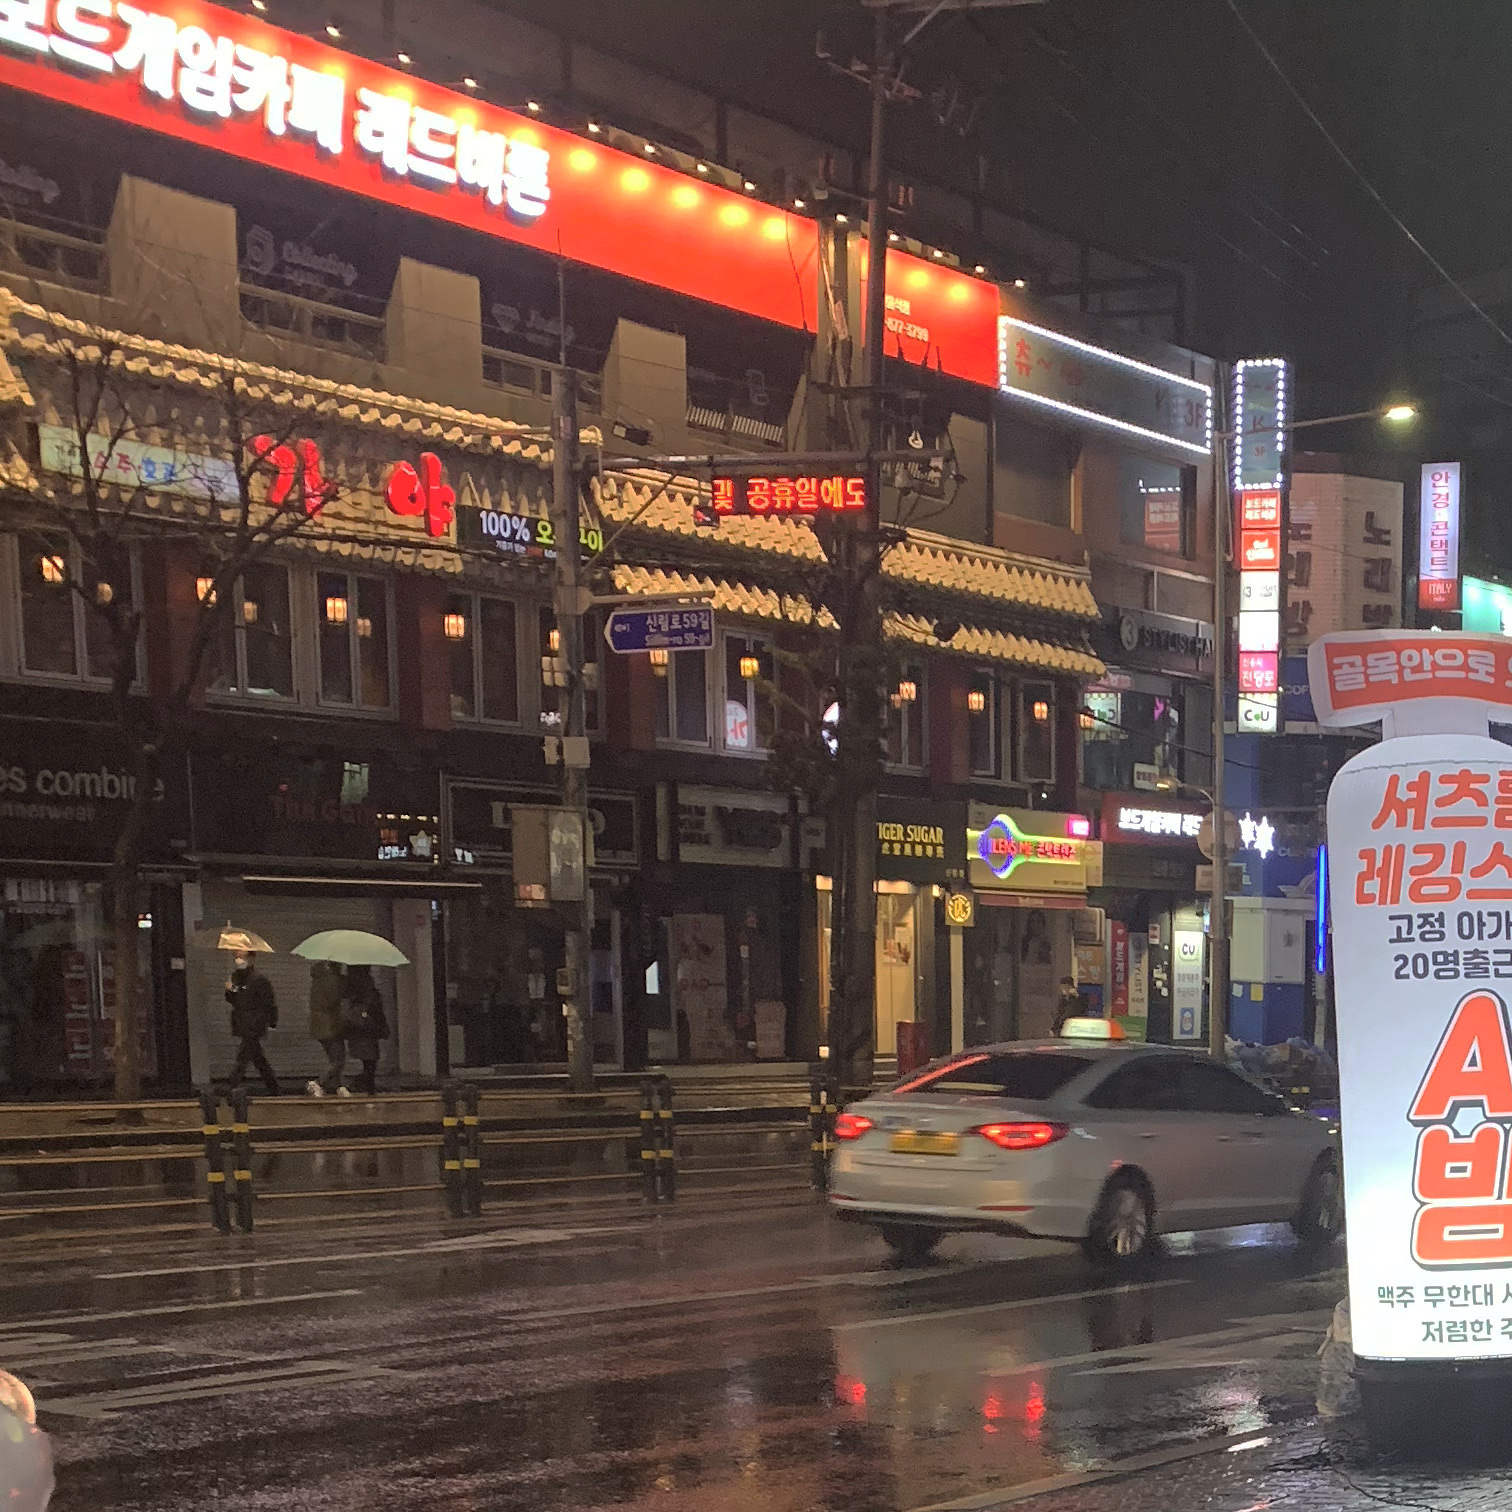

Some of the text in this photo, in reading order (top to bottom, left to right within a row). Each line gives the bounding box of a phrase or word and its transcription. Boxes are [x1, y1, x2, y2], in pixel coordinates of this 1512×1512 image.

[356, 87, 550, 218] 레드버튼
[747, 476, 865, 511] 공휴일에도
[480, 510, 530, 542] 100%
[1332, 649, 1496, 692] 골목안으로
[876, 822, 944, 845] IGER SUGAR
[1388, 911, 1446, 944] 고정
[1181, 943, 1196, 956] CU
[1378, 1286, 1415, 1308] 맥주
[1424, 1284, 1494, 1308] 무한대
[1422, 1318, 1493, 1343] 저렴한
